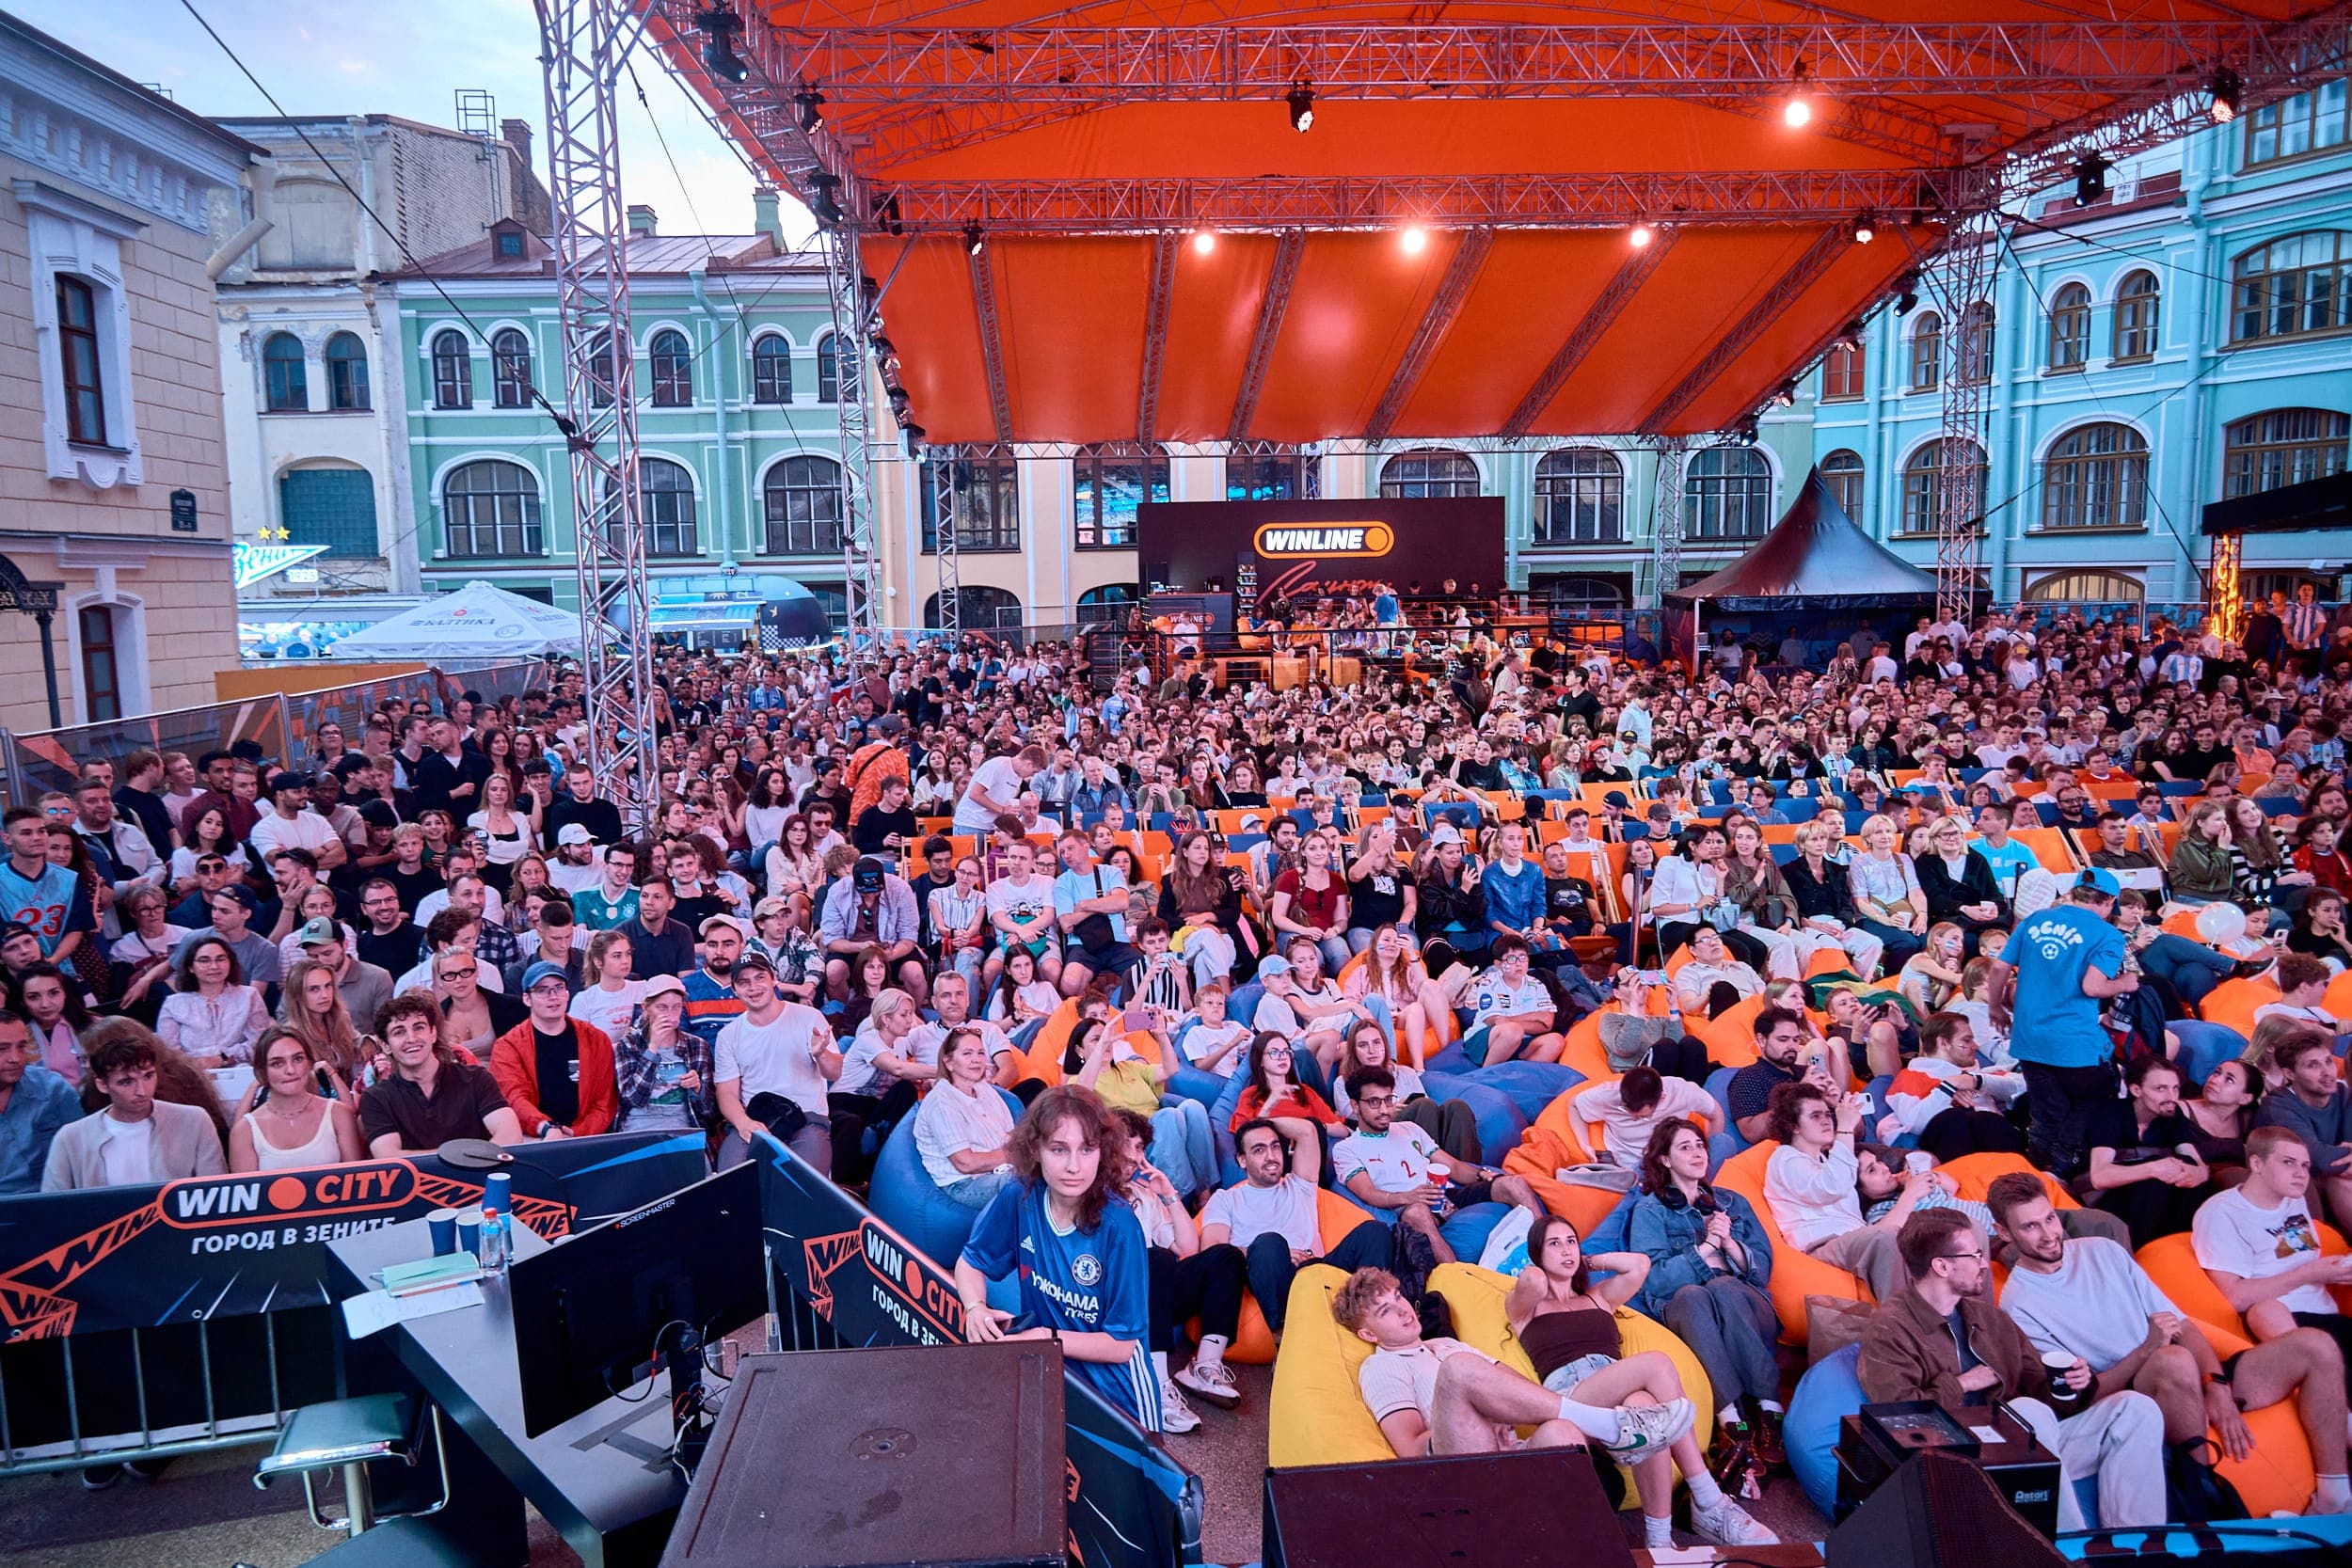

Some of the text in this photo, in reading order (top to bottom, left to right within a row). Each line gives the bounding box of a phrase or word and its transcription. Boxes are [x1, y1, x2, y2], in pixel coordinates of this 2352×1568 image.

[1265, 529, 1364, 551] WINLINE
[13, 904, 67, 938] 23
[1401, 1160, 1417, 1179] 2
[178, 1182, 261, 1218] WIN
[315, 1168, 402, 1204] CITY
[620, 1198, 676, 1228] SCREENMASTER
[191, 1230, 276, 1255] ГОРОД
[282, 1227, 297, 1245] В
[866, 1228, 968, 1336] WIN CITY
[1031, 1271, 1100, 1310] YOKOHAMA
[871, 1284, 910, 1335] ГОРОД
[911, 1317, 920, 1339] В
[1064, 1307, 1099, 1324] TYRES
